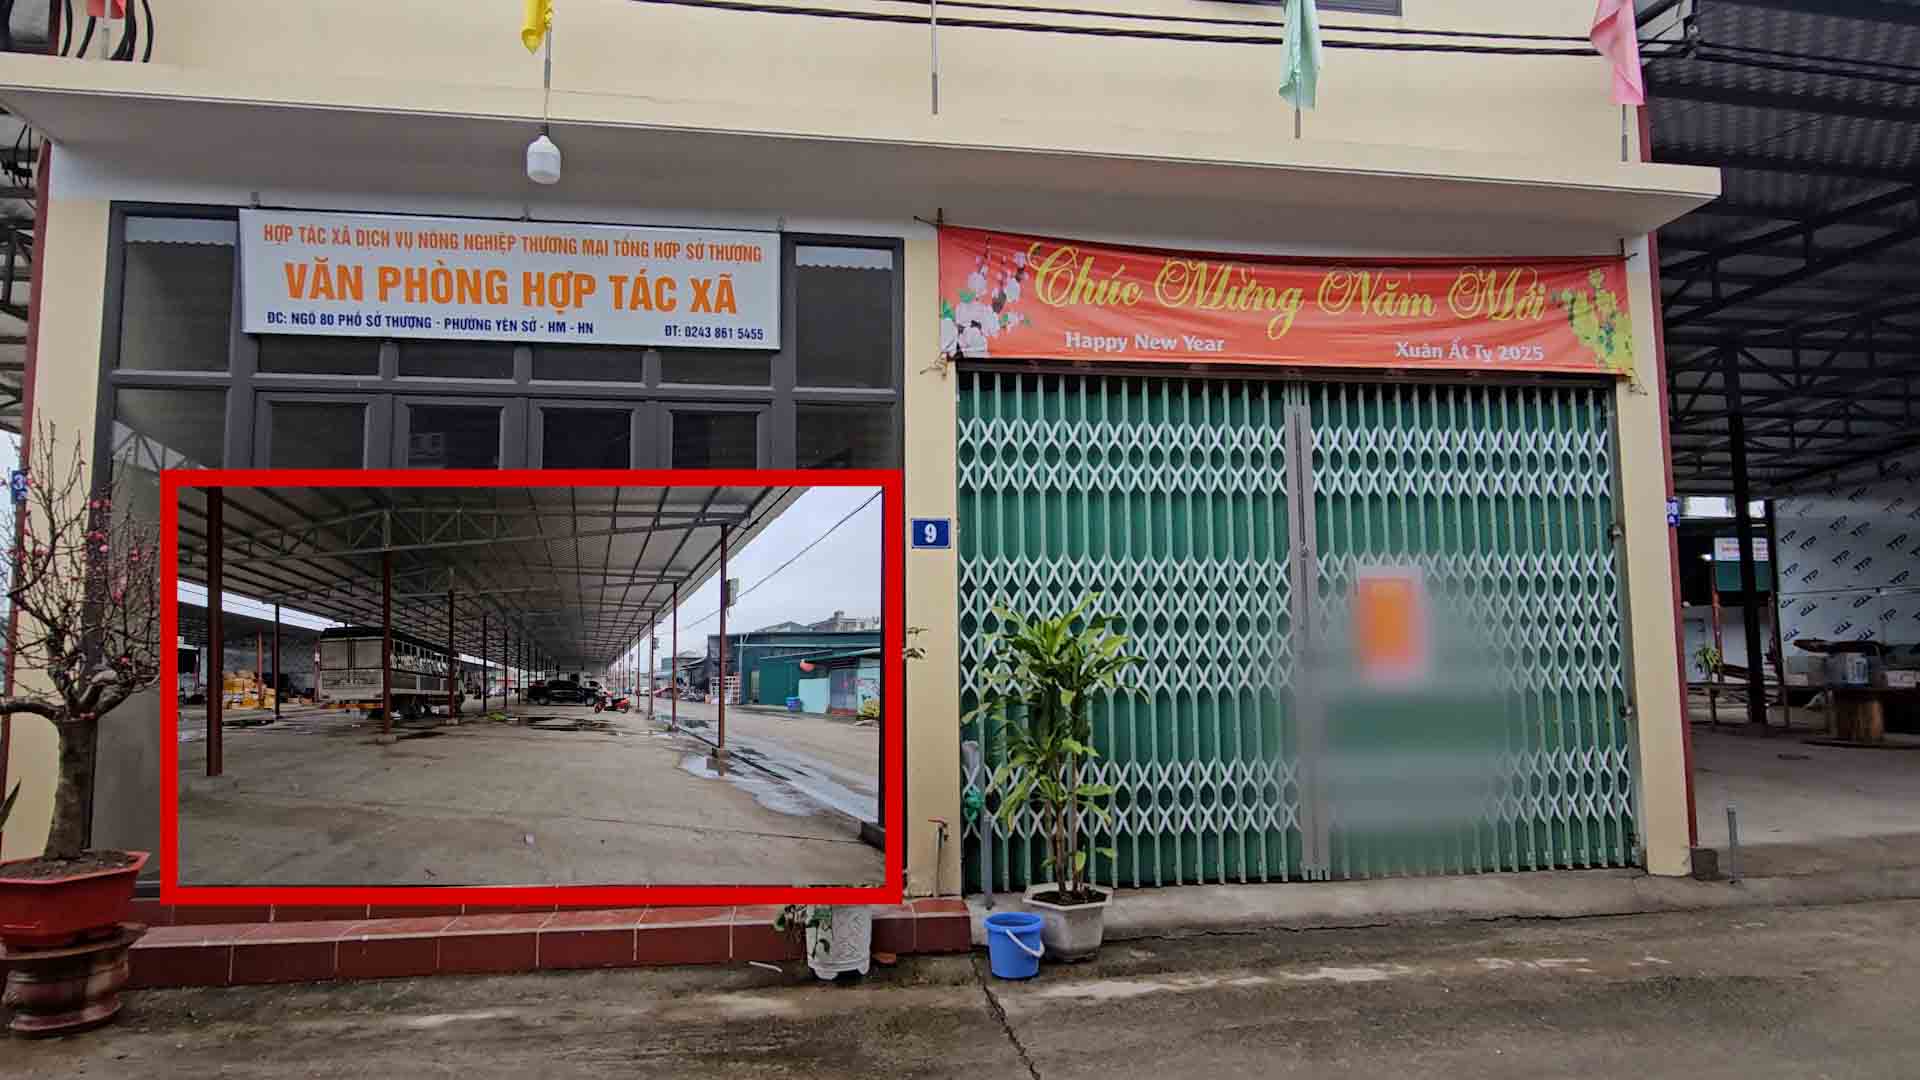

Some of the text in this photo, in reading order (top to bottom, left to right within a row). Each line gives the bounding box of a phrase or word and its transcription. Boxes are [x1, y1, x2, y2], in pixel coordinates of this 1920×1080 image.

[263, 223, 293, 246] HỢP
[298, 224, 327, 244] TÁC
[355, 229, 390, 250] DỊCH
[395, 231, 414, 252] VỤ
[417, 229, 459, 249] NÔNG
[463, 231, 517, 255] NGHIỆP
[520, 235, 577, 255] THƯƠNG
[582, 237, 609, 259] MẠI
[614, 234, 649, 257] TỔNG
[654, 240, 681, 261] HỢP
[687, 238, 705, 261] SỞ
[708, 244, 762, 264] THƯỢNG
[284, 256, 738, 316] VĂN PHÒNG HỢP TÁC XÃ
[1027, 241, 1547, 340] Chúc Mừng Năm Mới
[267, 310, 287, 325] ĐC:
[320, 313, 334, 326] 80
[338, 310, 362, 328] PHỐ
[366, 310, 382, 328] SỞ
[386, 314, 432, 332] THƯỢNG
[444, 314, 492, 332] PHƯỜNG
[496, 316, 518, 332] YÊN
[521, 316, 537, 333] SỞ
[548, 320, 566, 334] HM
[578, 322, 593, 335] HN
[664, 324, 763, 341] ĐT: 0243 861 5455
[1064, 330, 1225, 353] Happy New Year
[1395, 336, 1545, 363] Xuân Ất Tỵ 2025
[924, 523, 937, 543] 9
